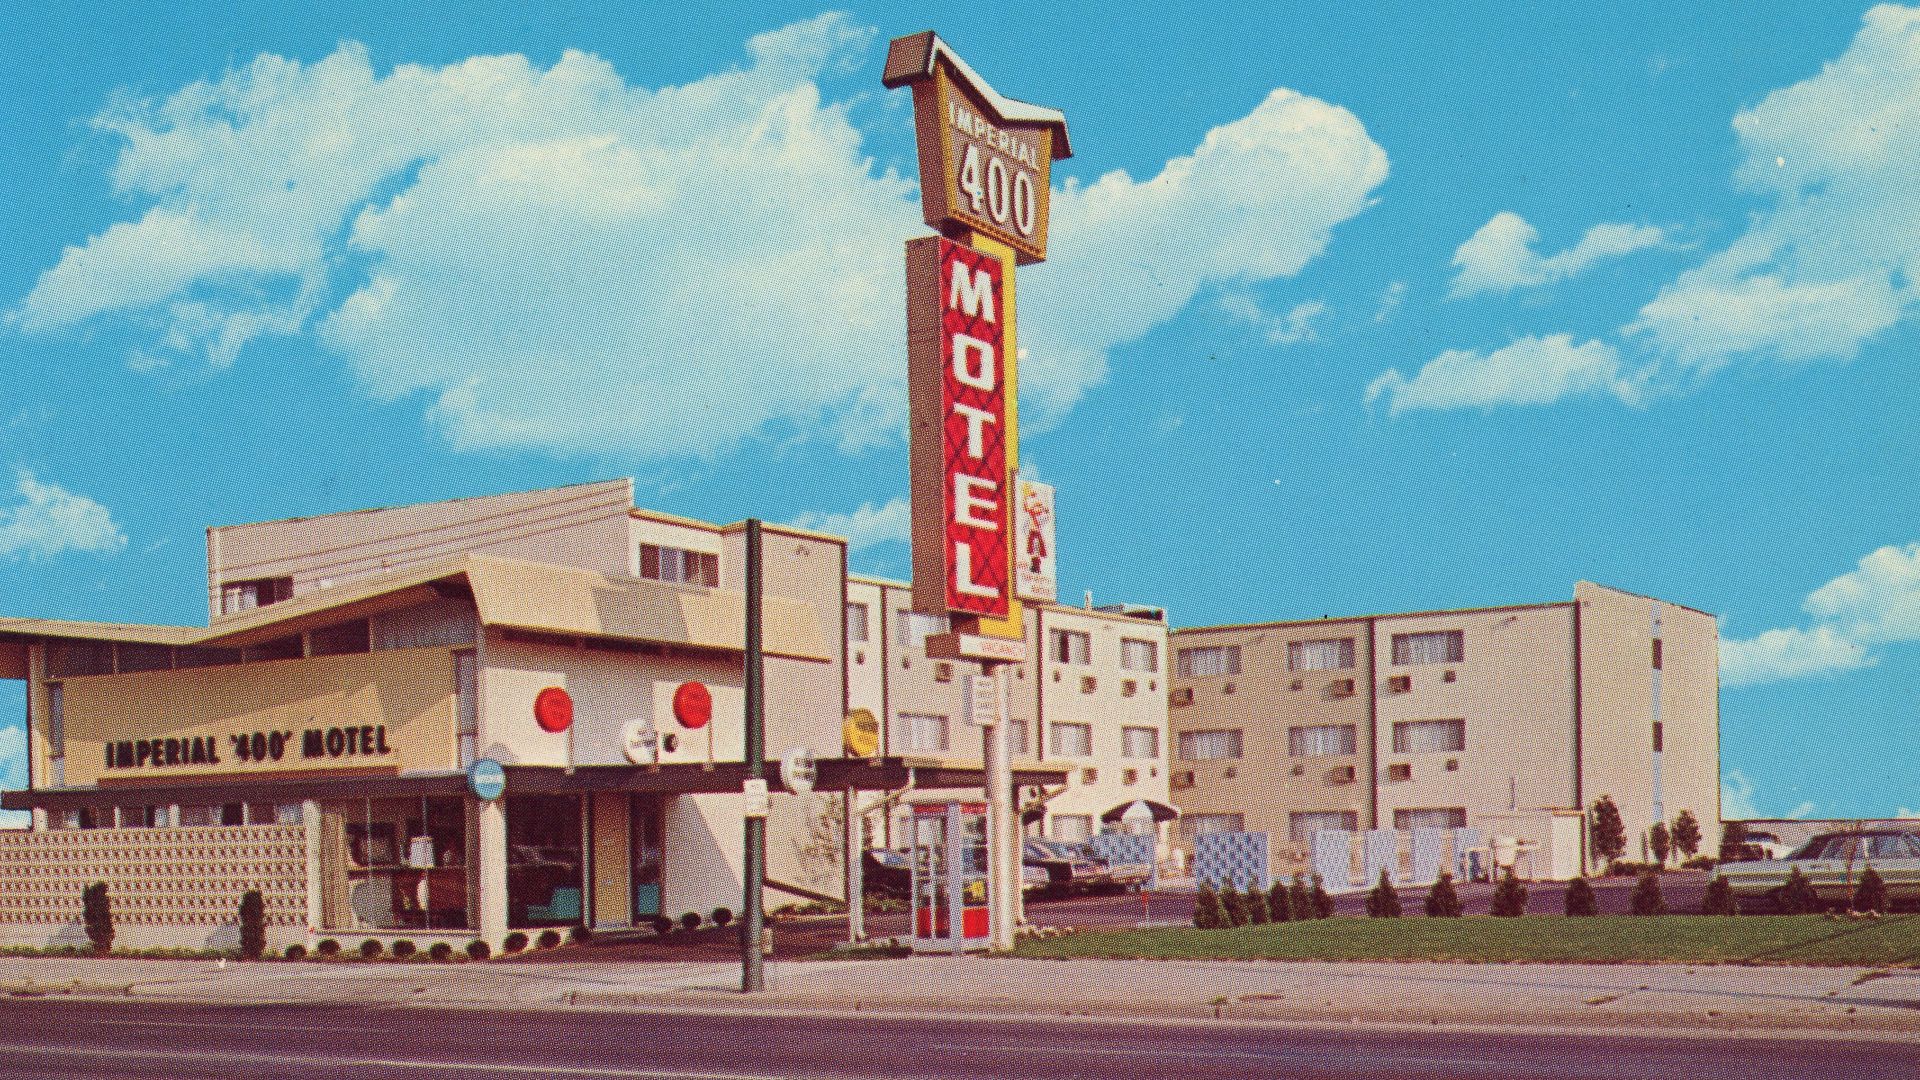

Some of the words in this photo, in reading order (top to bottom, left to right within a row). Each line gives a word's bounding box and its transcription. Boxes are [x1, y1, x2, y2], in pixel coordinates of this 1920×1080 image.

[949, 101, 1039, 171] IMPERIAL
[961, 143, 1034, 236] 400
[951, 260, 999, 597] MOTEL
[105, 735, 221, 768] IMPERIAL
[302, 725, 391, 758] MOTEL
